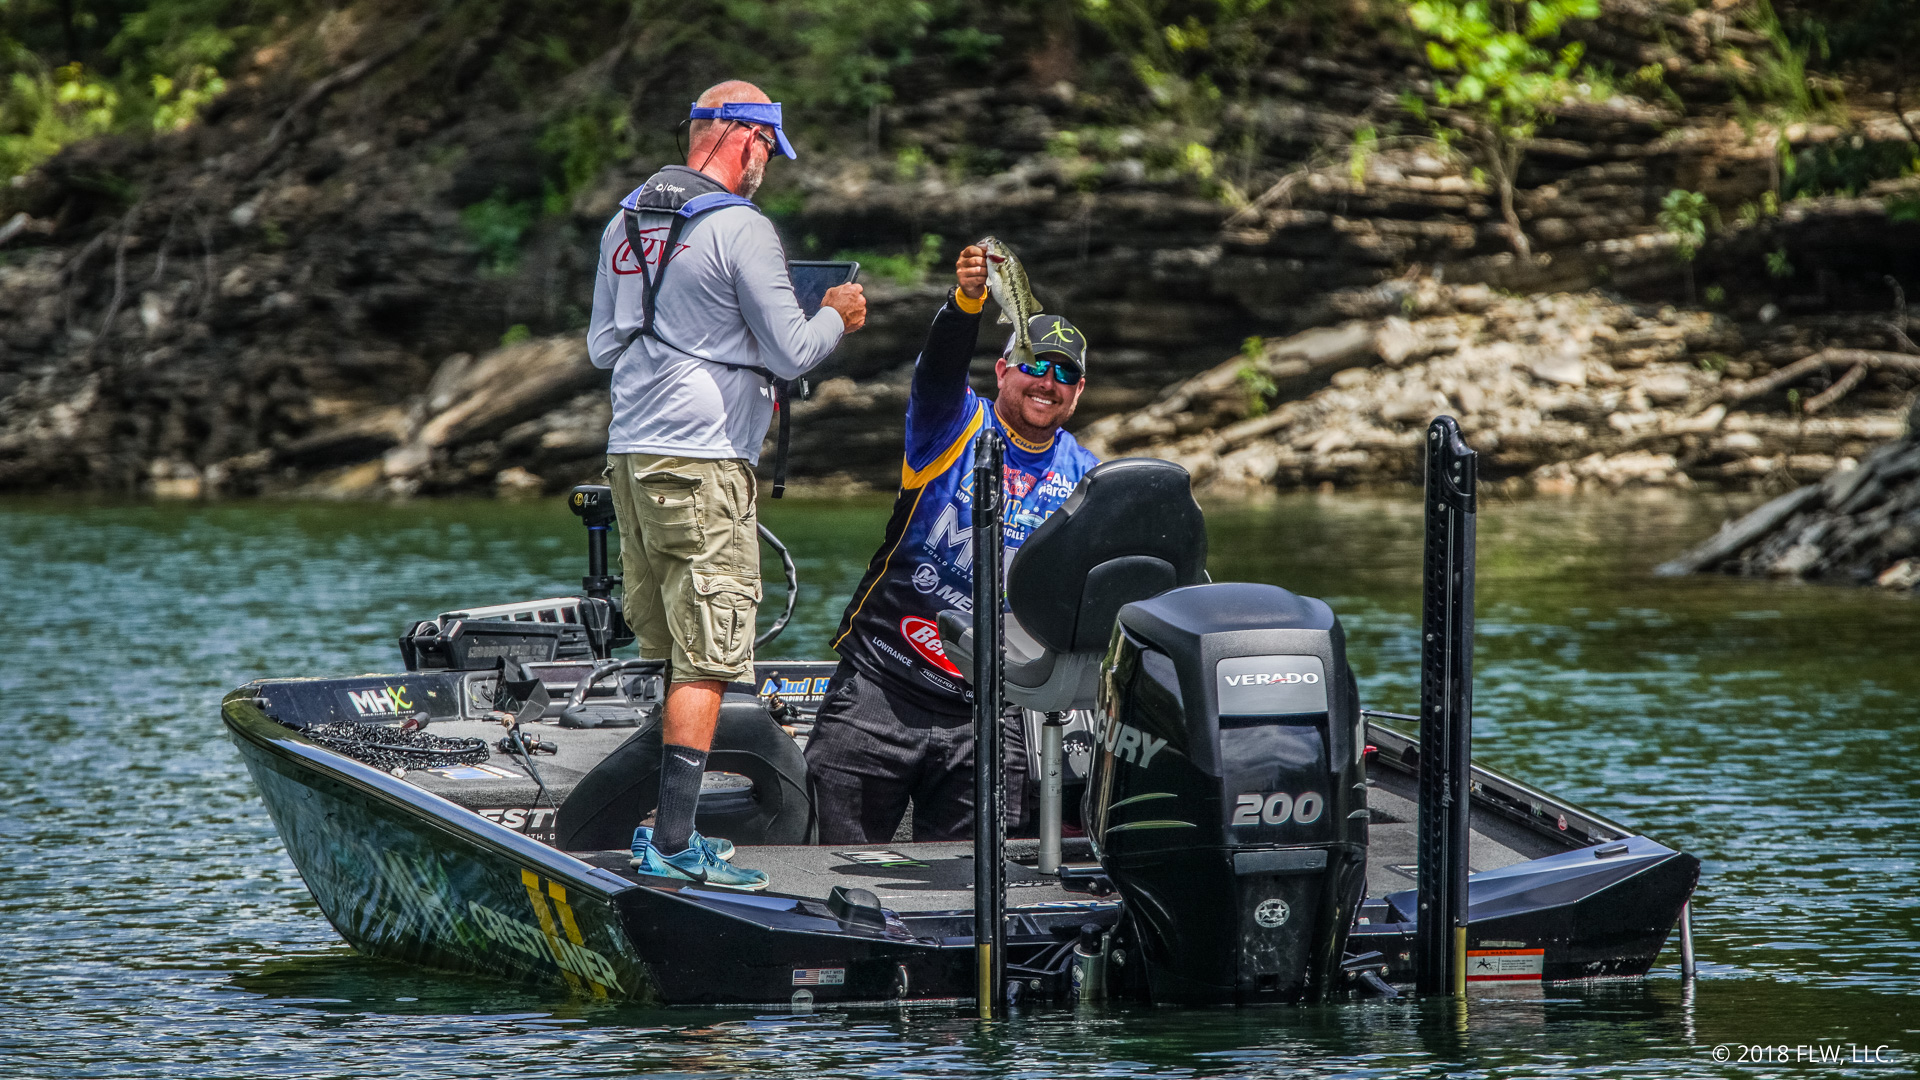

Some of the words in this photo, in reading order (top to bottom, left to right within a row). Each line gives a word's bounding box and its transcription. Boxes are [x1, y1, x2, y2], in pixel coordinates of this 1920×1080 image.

[1051, 472, 1078, 493] Abu
[922, 545, 949, 567] WORLD
[950, 566, 973, 584] CLAS
[872, 636, 913, 667] LOWRANCE
[1224, 672, 1319, 687] VERADO
[347, 685, 414, 717] MHX
[1094, 704, 1169, 769] CURY
[1231, 791, 1324, 826] 200
[468, 900, 626, 994] CRESTLINER
